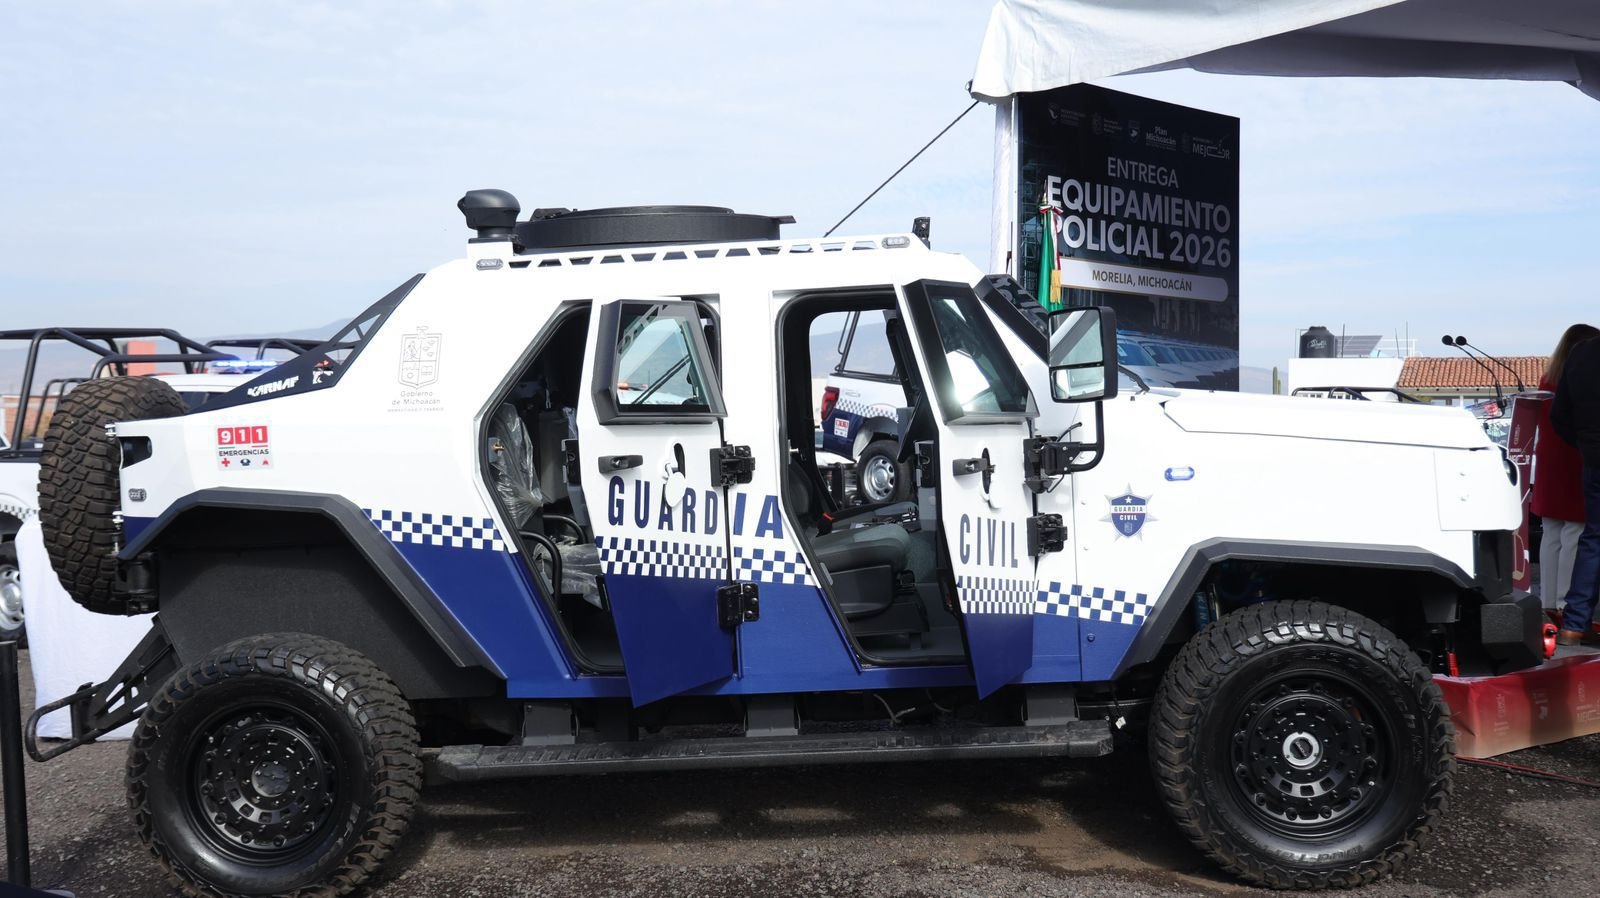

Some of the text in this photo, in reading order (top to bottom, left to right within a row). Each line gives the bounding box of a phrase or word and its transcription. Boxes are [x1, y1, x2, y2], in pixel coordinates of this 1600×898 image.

[1107, 156, 1179, 189] ENTREGA
[1047, 175, 1231, 233] EQUIPAMIENTO
[1169, 230, 1231, 268] 2026
[1092, 269, 1192, 292] MORELIA, MICHOACÁN
[221, 428, 263, 443] 911
[218, 449, 269, 457] EMERGENCIAS
[959, 513, 1018, 568] CIVIL
